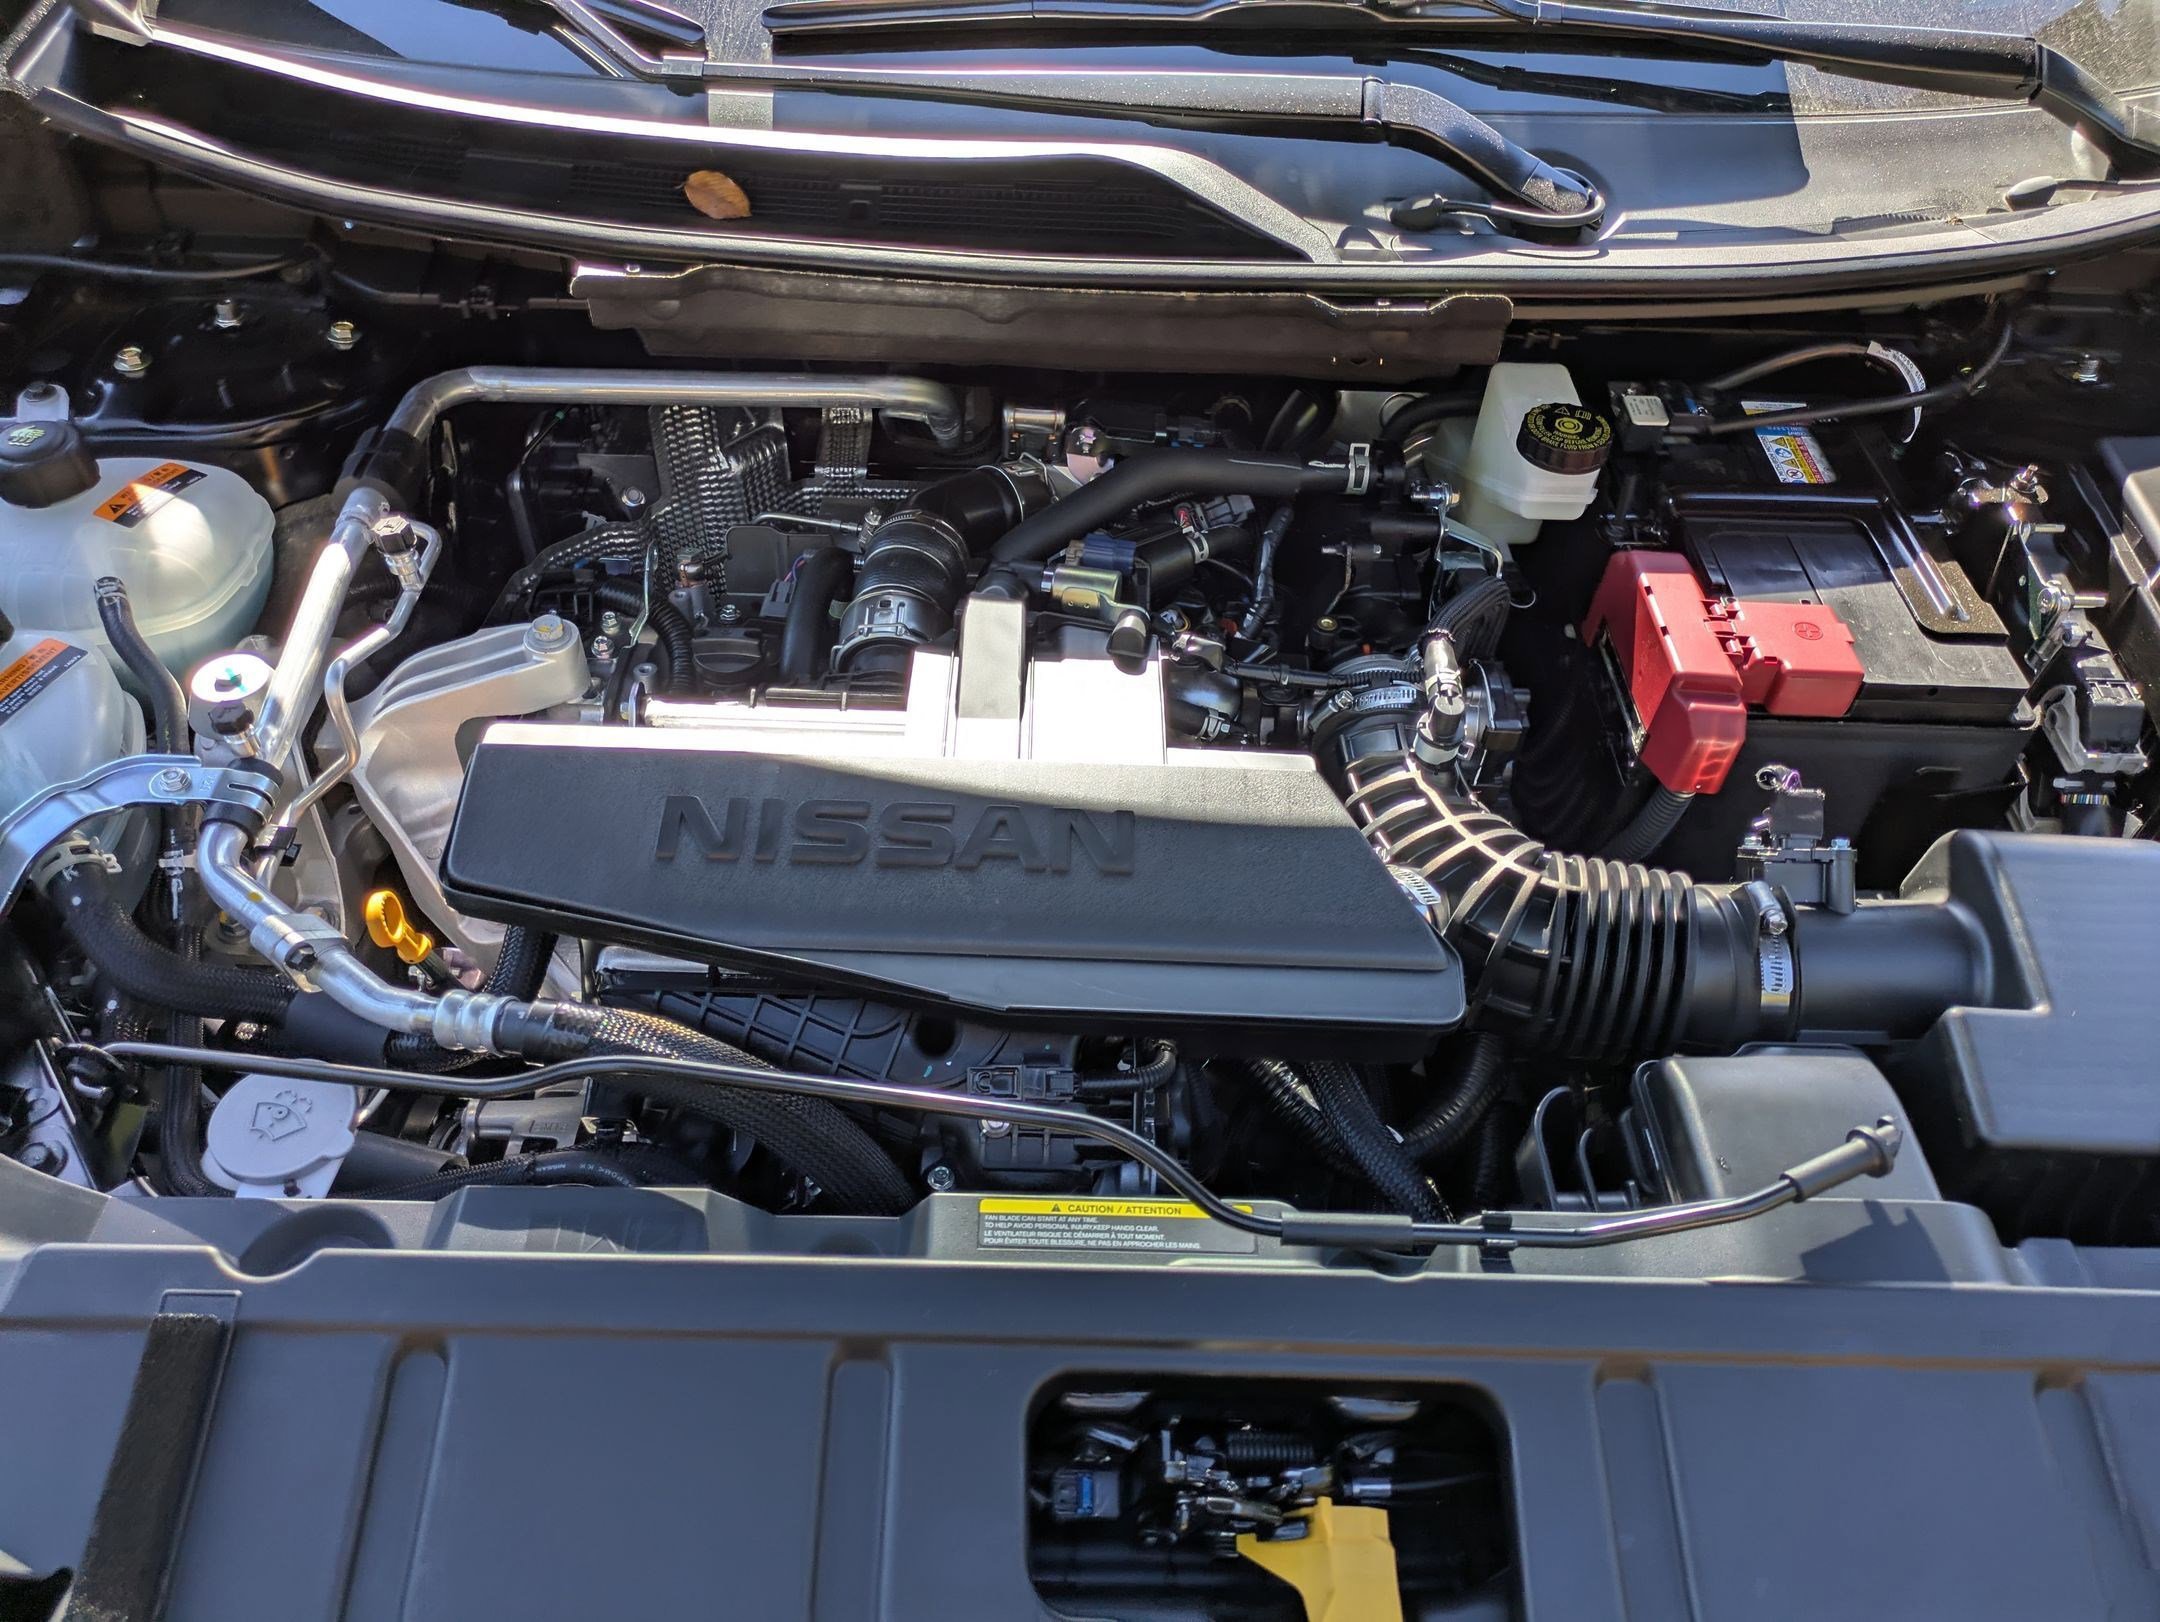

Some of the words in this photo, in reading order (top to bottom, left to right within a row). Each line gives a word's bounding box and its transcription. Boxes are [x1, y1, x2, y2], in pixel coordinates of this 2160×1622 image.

[656, 795, 1135, 876] NISSAN
[1067, 1204, 1114, 1213] CAUTION
[1125, 1206, 1182, 1215] ATTENTION
[993, 1230, 1036, 1238] VENTILATEUR
[1037, 1231, 1061, 1239] RISQUE
[1073, 1230, 1110, 1239] DÉMARRER
[1110, 1231, 1116, 1239] À
[983, 1237, 1004, 1245] POUR
[1004, 1236, 1028, 1245] ÉVITER
